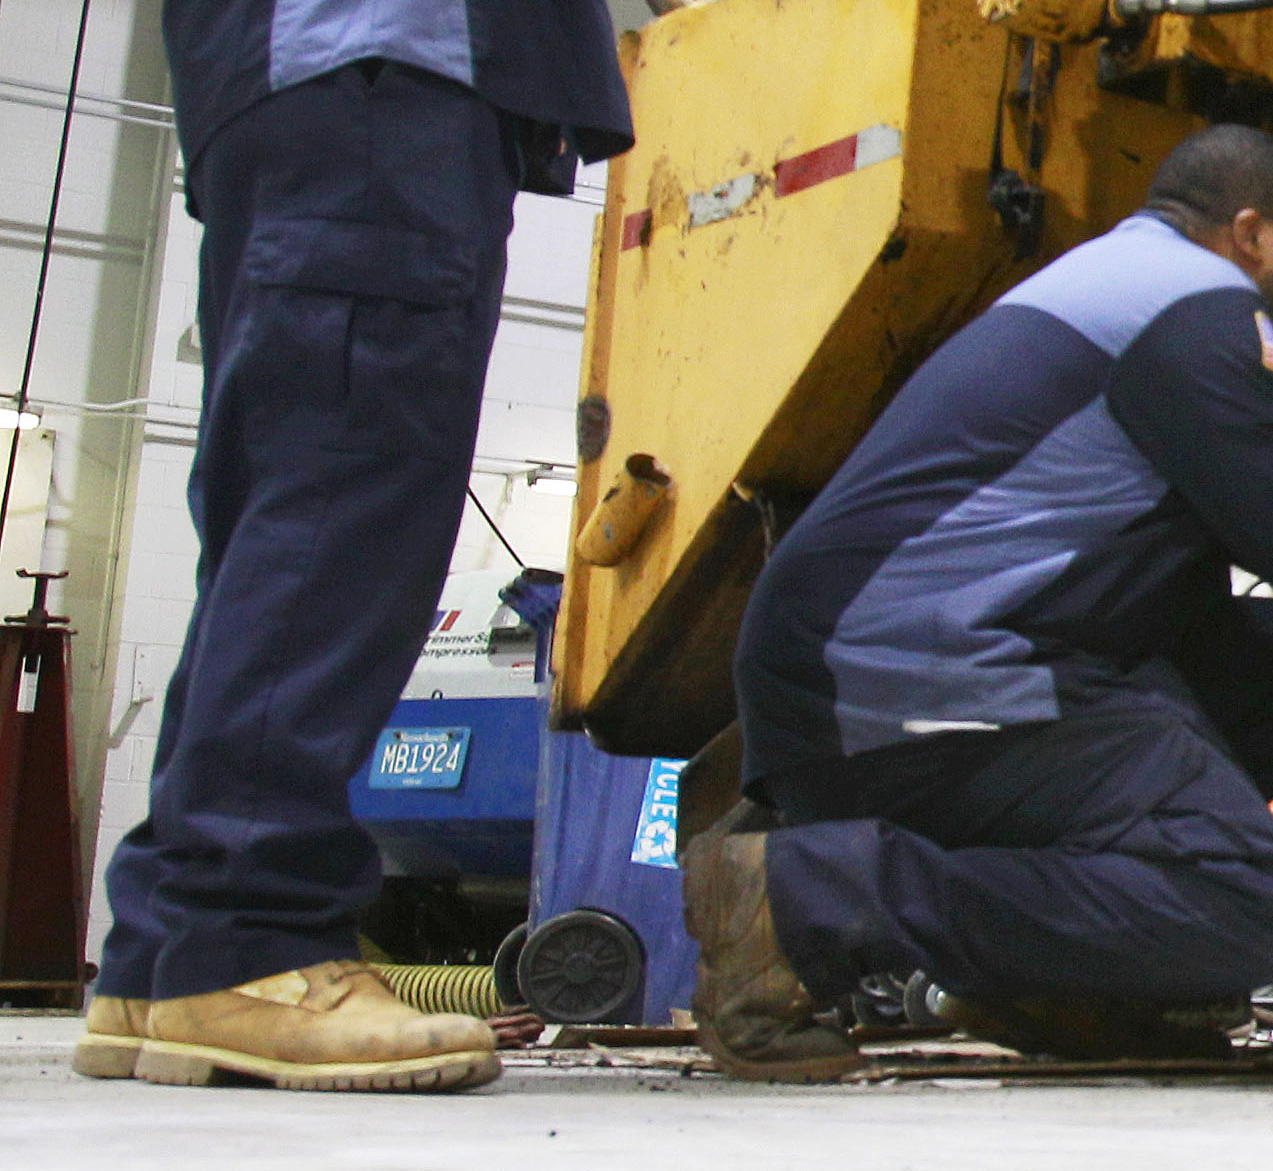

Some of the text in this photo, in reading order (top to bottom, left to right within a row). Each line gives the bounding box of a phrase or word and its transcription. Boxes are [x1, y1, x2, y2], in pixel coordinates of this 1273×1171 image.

[420, 646, 497, 658] ompressors
[380, 743, 461, 775] MB1924
[651, 760, 689, 820] YCLE
